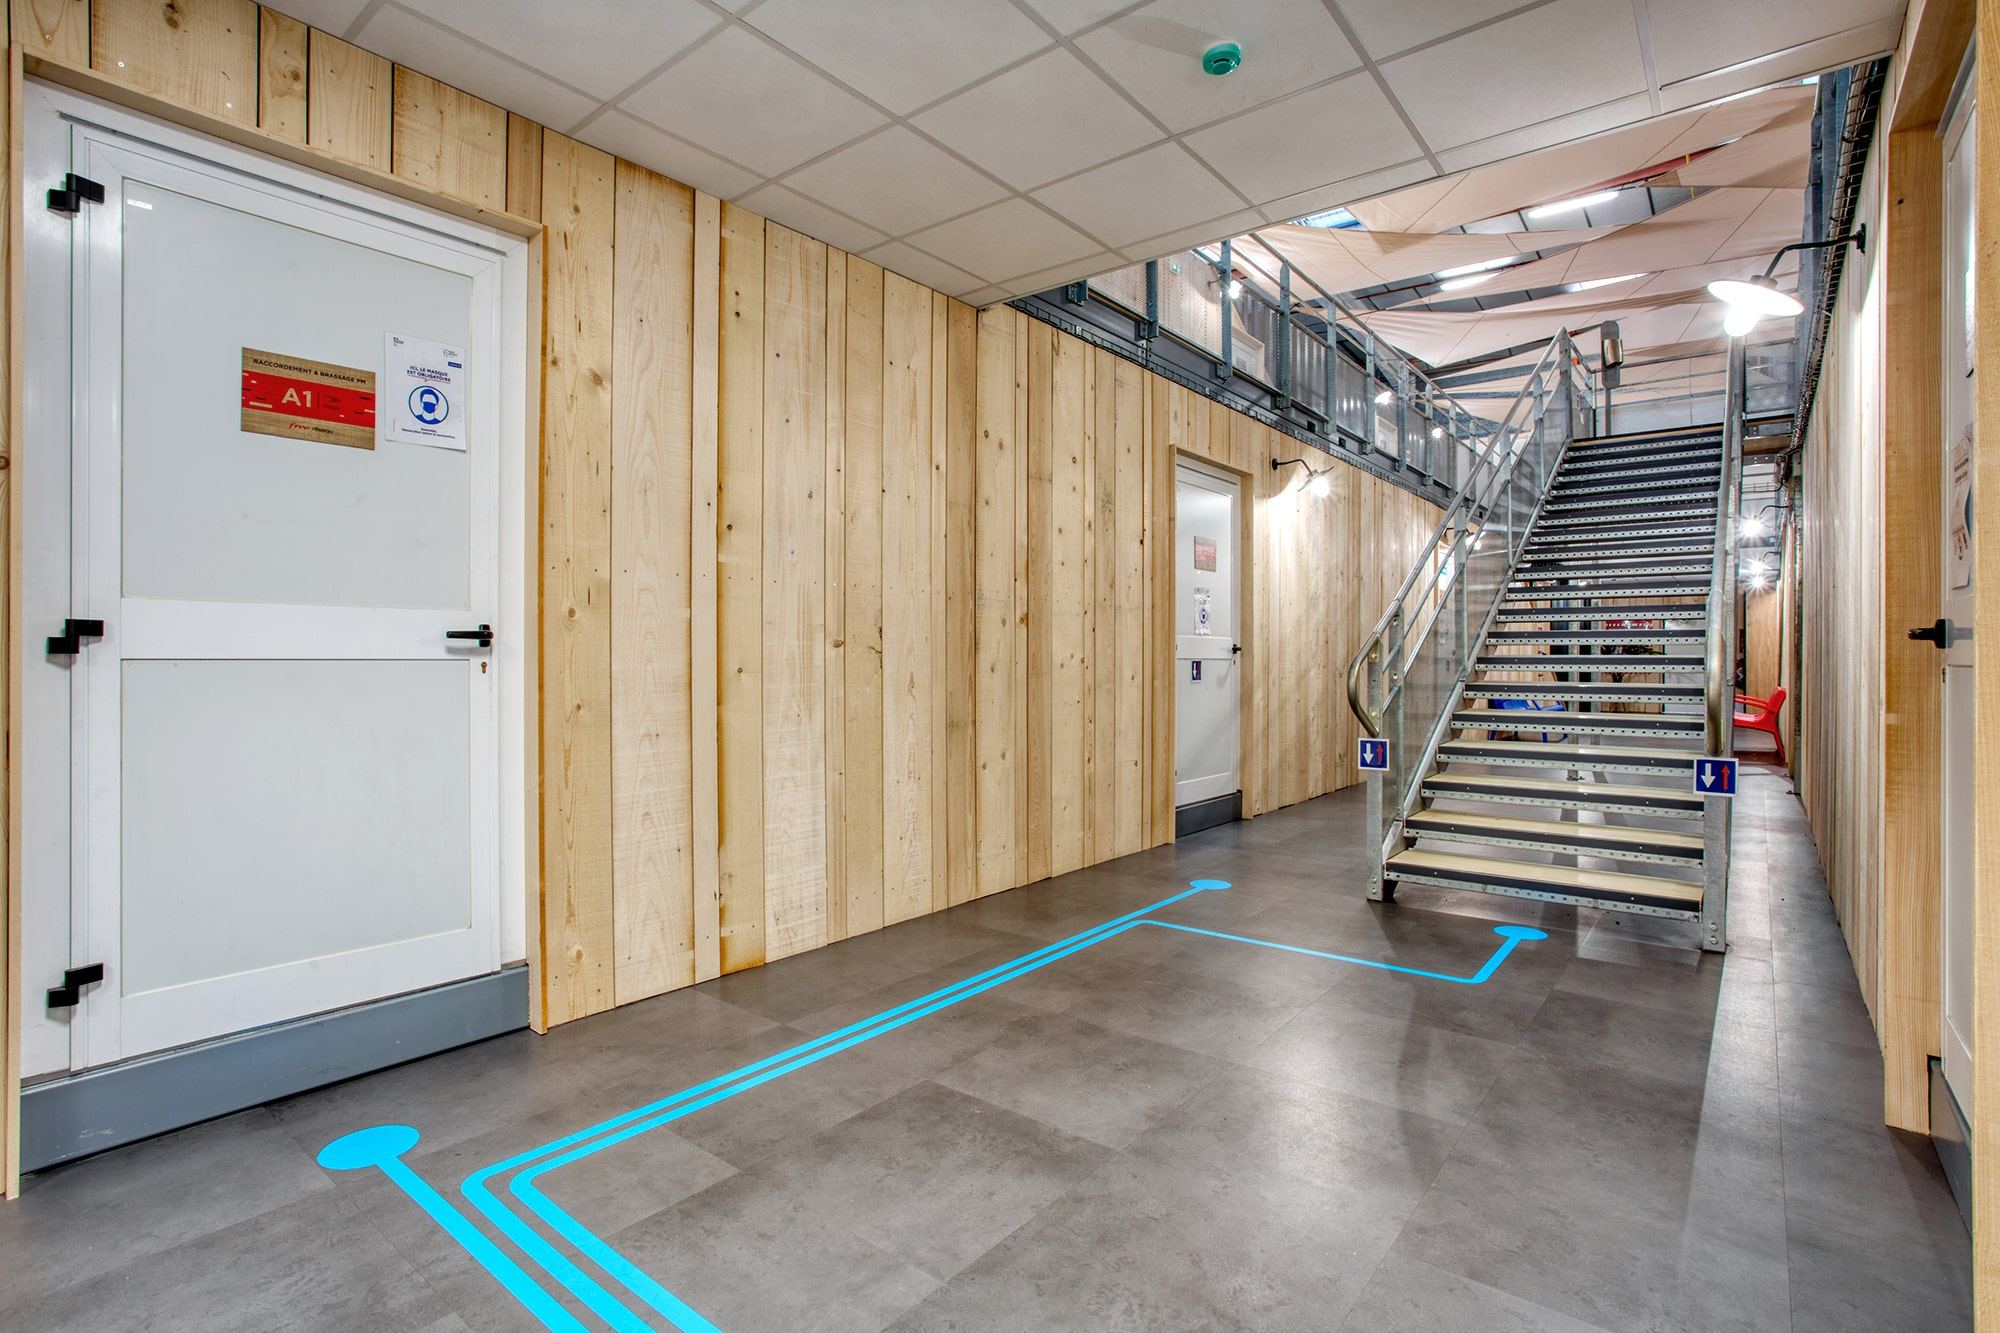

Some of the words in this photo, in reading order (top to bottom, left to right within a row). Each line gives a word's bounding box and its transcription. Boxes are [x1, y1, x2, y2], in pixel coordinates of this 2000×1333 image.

[253, 358, 312, 375] RACCORDEMENT
[320, 371, 355, 382] BRASSAGE
[417, 371, 450, 382] OBLIGATOIRE
[427, 368, 447, 376] MASQUE
[281, 387, 312, 408] A1
